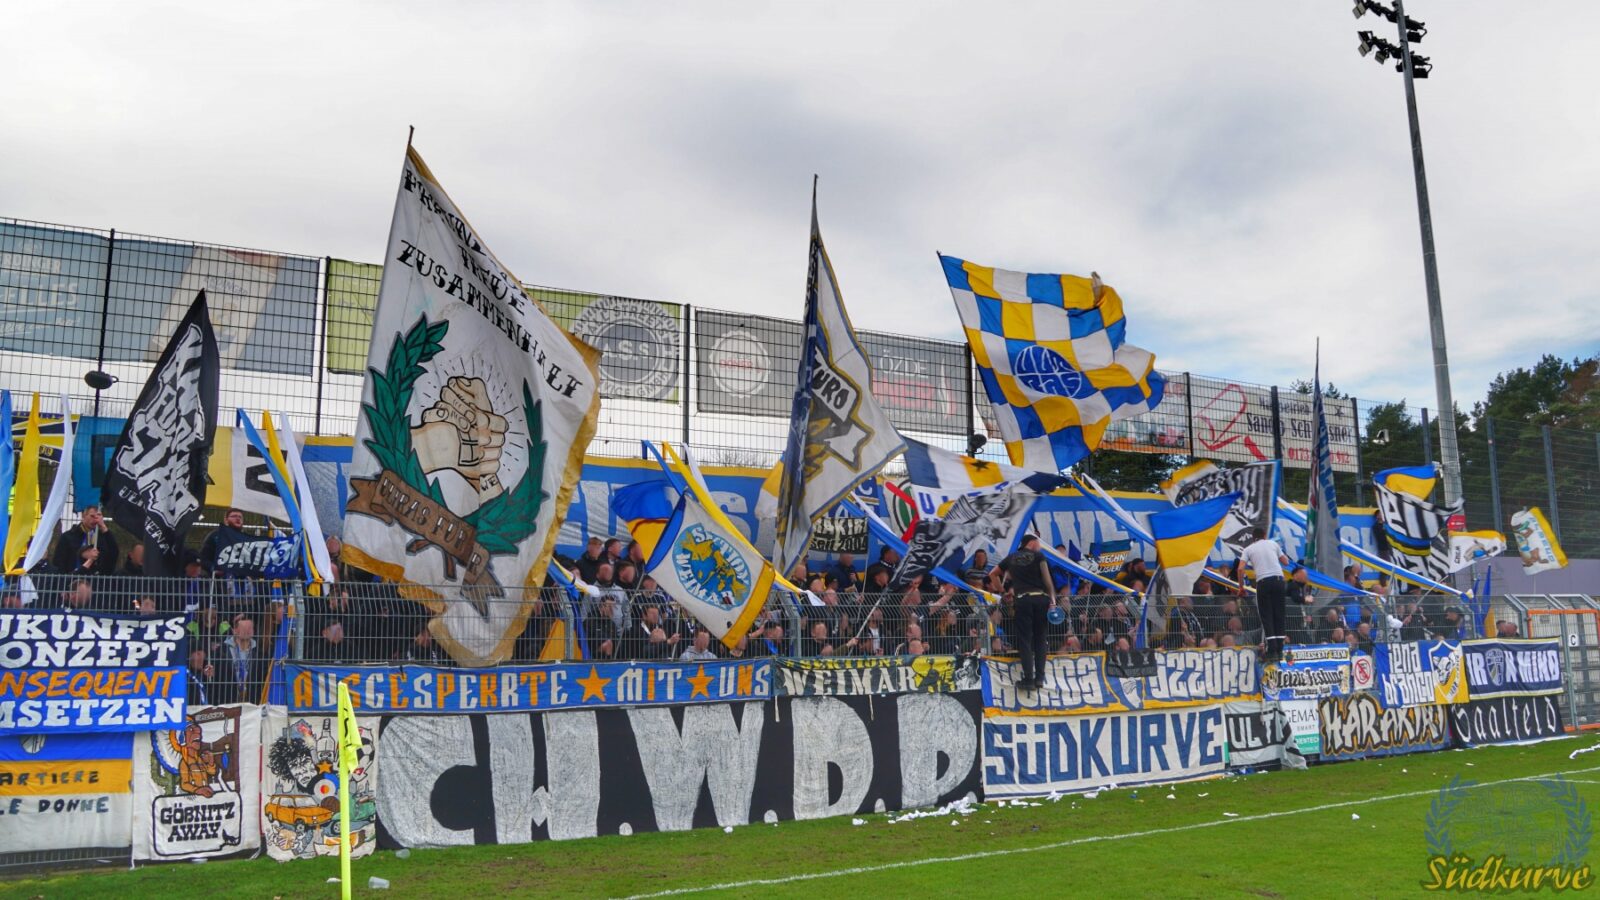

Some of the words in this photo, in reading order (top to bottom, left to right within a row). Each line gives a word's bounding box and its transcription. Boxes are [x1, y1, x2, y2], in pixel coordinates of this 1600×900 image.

[397, 240, 583, 399] ZUSAMMENHALT
[675, 552, 737, 607] WEIMAR
[293, 669, 568, 710] AUSGESPERRTE
[617, 667, 682, 700] MIT
[718, 663, 770, 698] UNS
[780, 666, 919, 697] WEIMAR
[1321, 697, 1445, 752] HARAKIRI
[1452, 696, 1557, 743] Saalfeld
[984, 708, 1223, 786] SÜDKURVE
[38, 796, 110, 815] DONNE
[167, 822, 222, 843] AWAY
